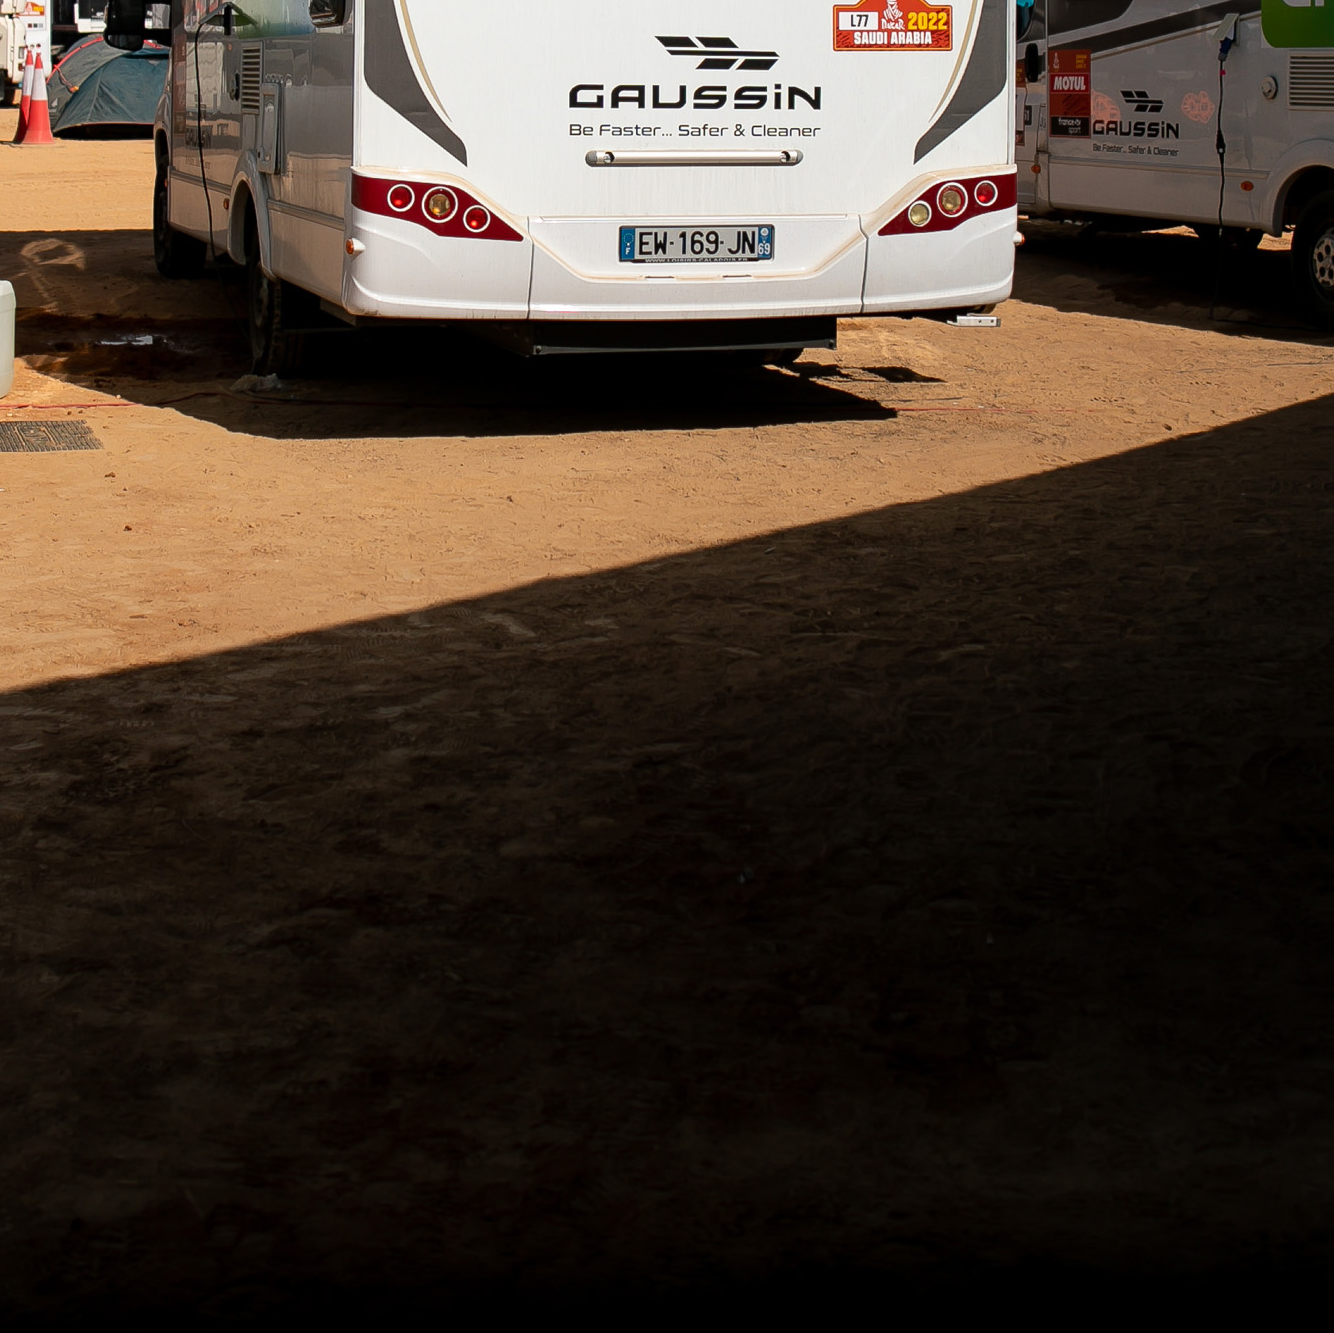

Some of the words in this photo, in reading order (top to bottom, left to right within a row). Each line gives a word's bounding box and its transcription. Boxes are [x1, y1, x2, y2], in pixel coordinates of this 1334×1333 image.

[851, 14, 869, 27] L77
[908, 12, 947, 30] 2022
[854, 32, 887, 45] SAUDI
[890, 32, 932, 45] ARABIA
[1053, 76, 1086, 91] MOTUL
[569, 124, 593, 136] Be
[599, 124, 673, 136] Faster...
[678, 124, 729, 137] Safer
[733, 124, 746, 137] &
[751, 124, 821, 137] Cleaner
[639, 231, 756, 255] EW-169-JN
[758, 243, 771, 255] 69
[625, 247, 631, 255] F
